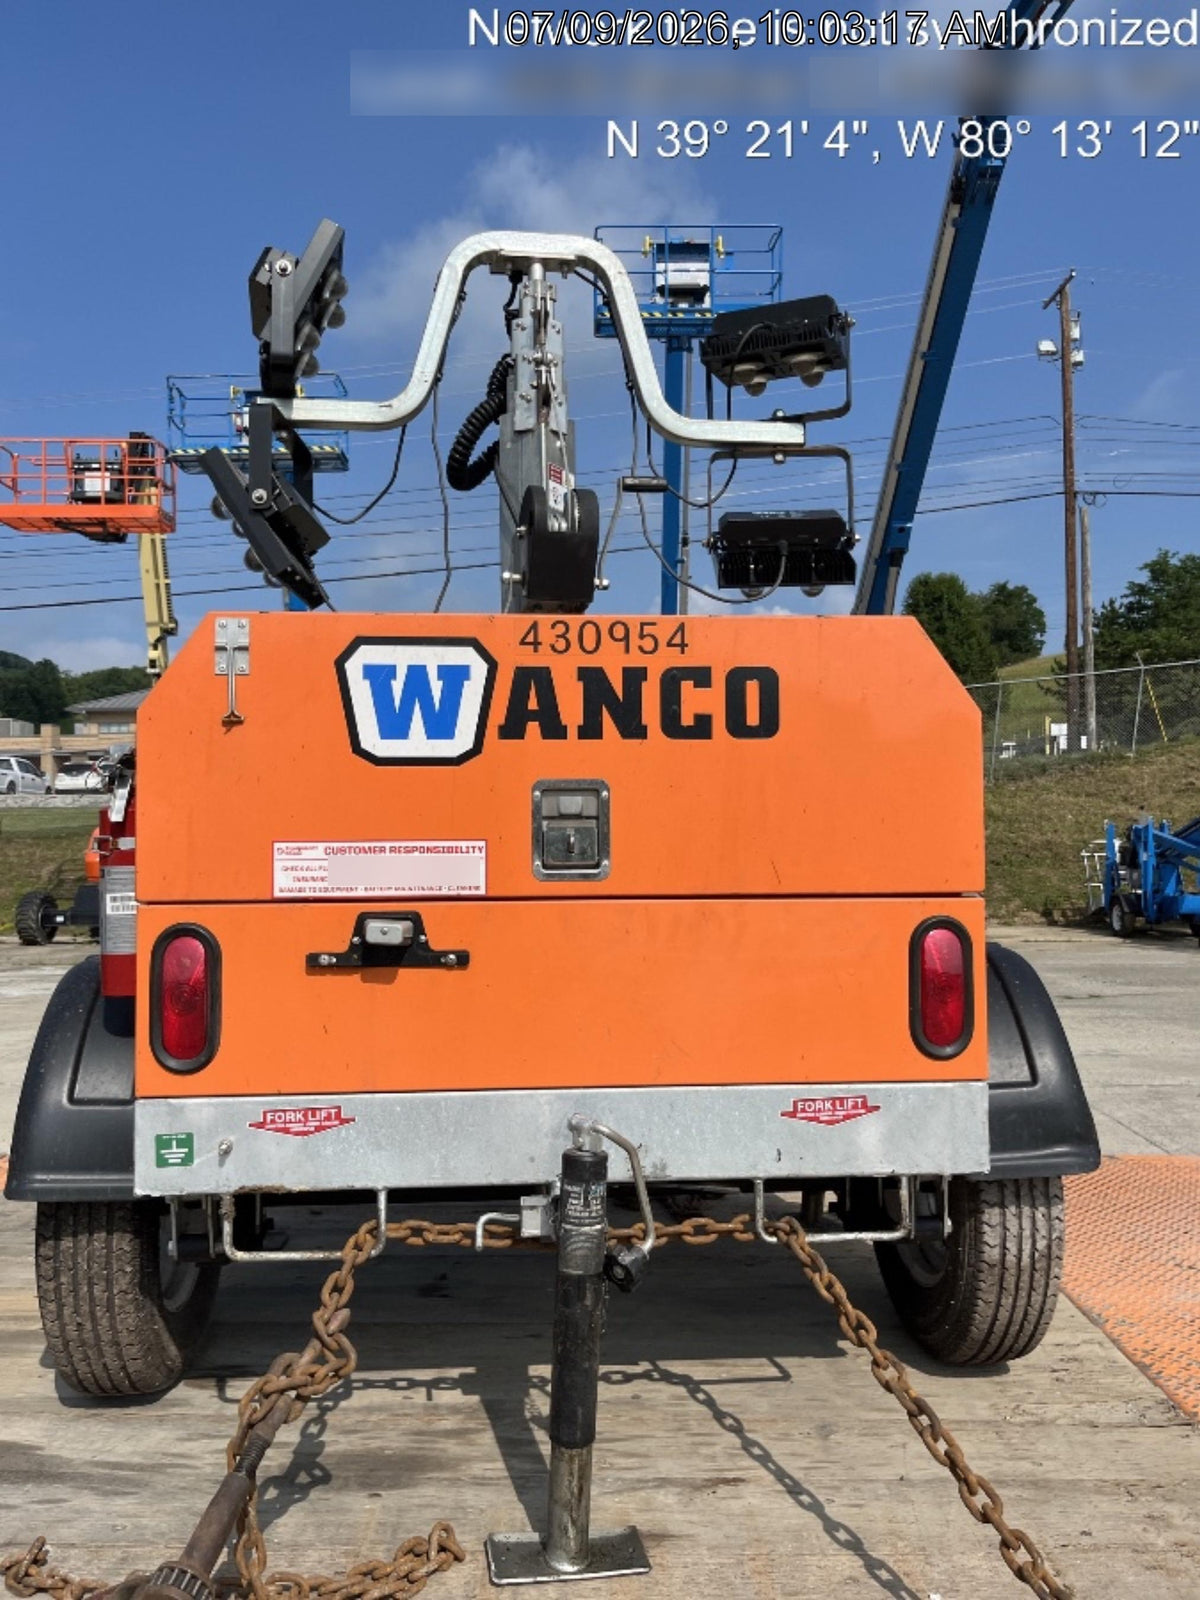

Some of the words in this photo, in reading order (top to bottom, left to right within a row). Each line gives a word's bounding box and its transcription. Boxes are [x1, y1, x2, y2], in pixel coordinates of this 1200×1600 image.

[518, 619, 689, 655] 430954
[362, 662, 780, 741] WANCO
[324, 845, 386, 856] CUSTOMER
[388, 845, 484, 855] RESPONSIBILITY
[797, 1100, 833, 1112] FORK
[835, 1098, 864, 1110] LIFT
[266, 1111, 305, 1123] FORK
[308, 1109, 338, 1121] LIFT
